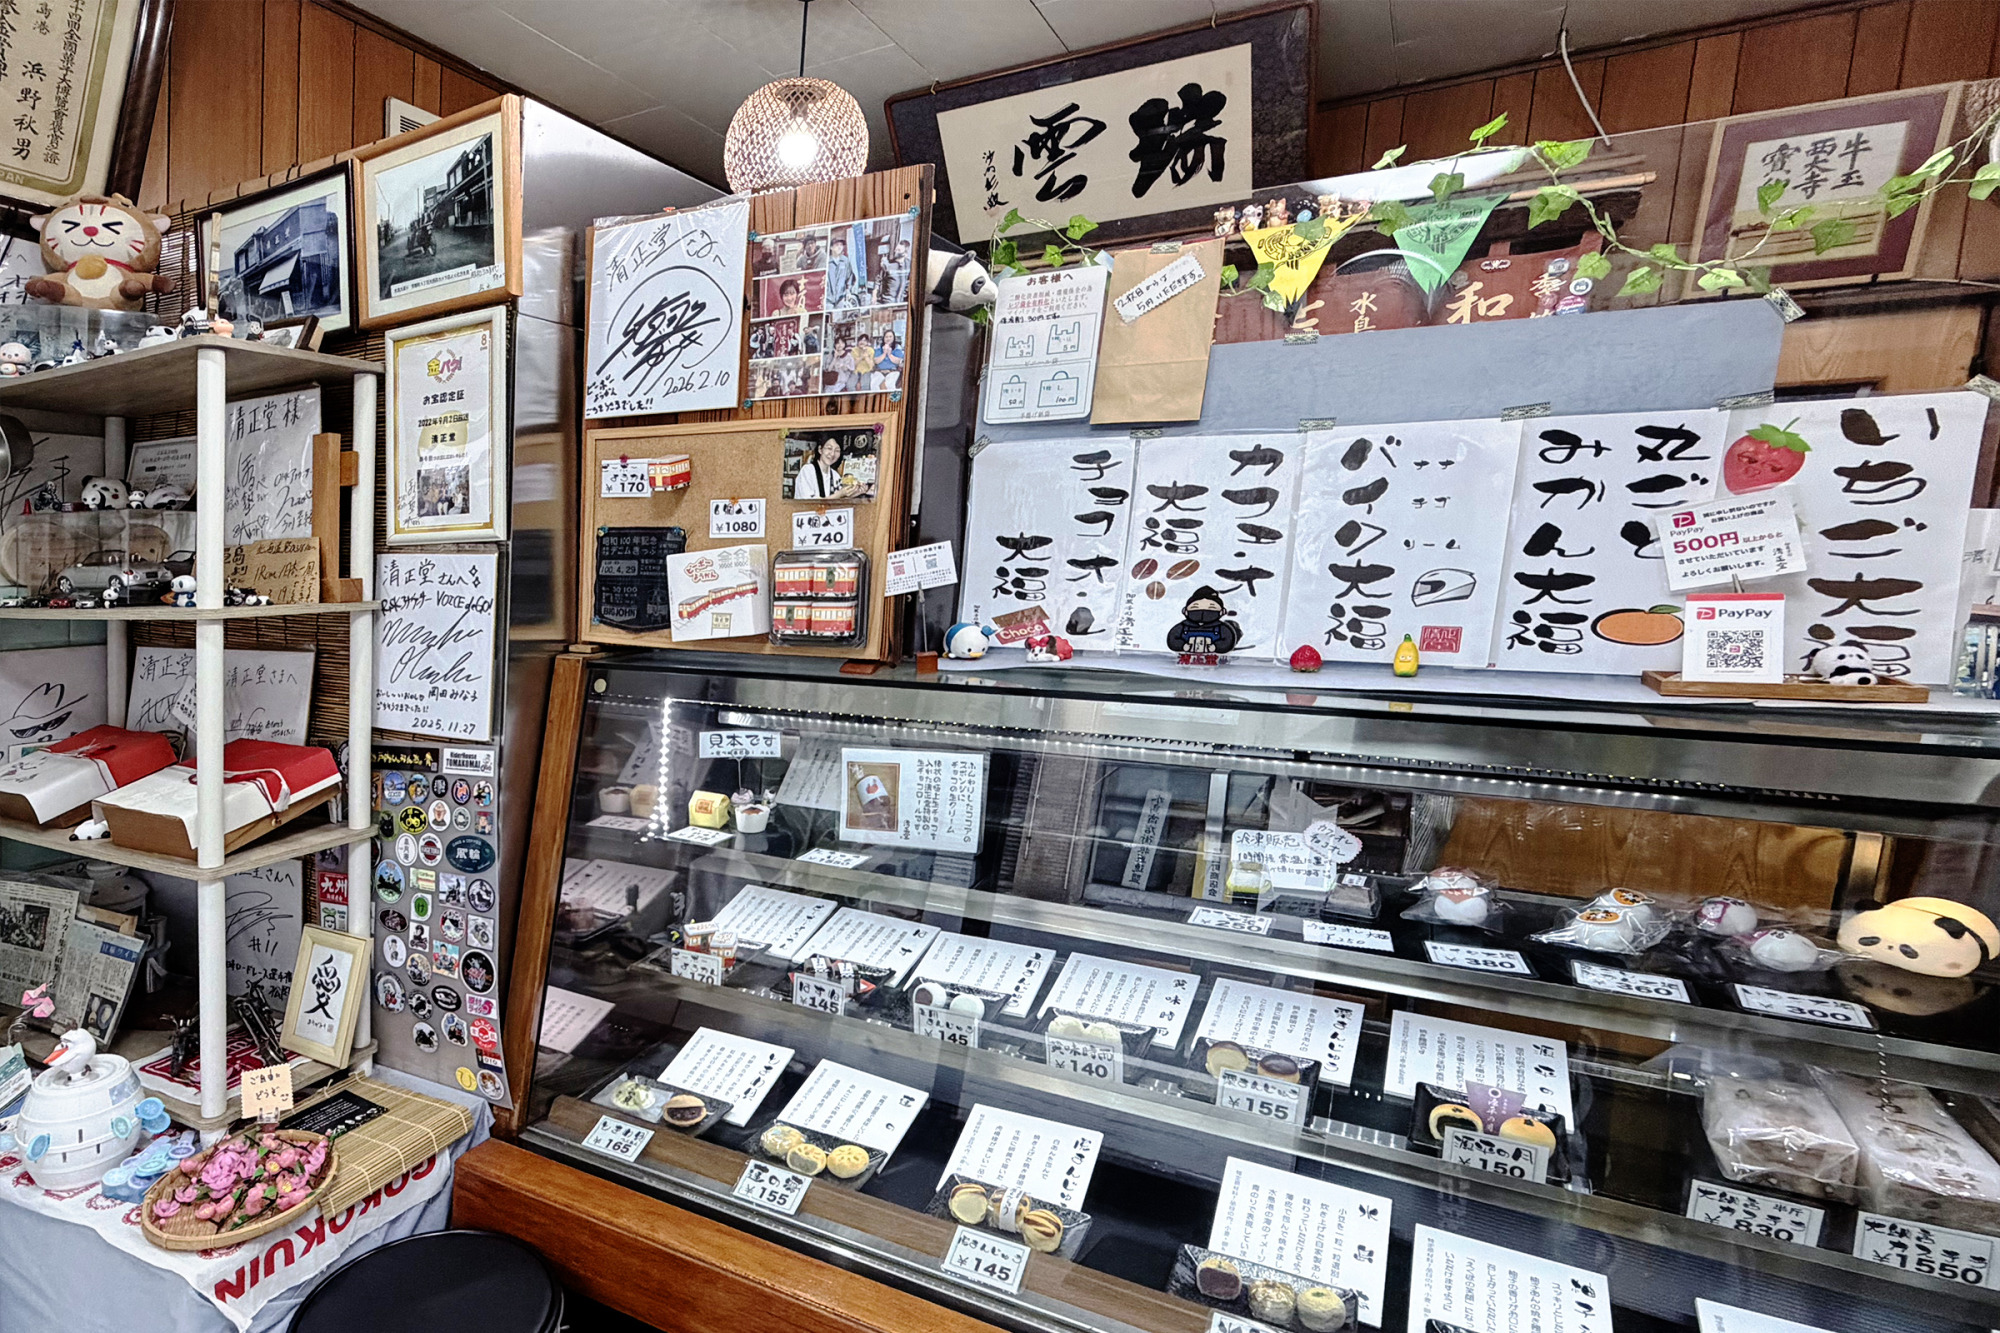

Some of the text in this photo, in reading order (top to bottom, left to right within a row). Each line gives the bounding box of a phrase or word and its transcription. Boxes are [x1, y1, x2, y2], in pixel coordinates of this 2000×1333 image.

[1027, 273, 1074, 286] お客様へ
[605, 482, 645, 493] ¥170
[715, 521, 757, 533] ¥1080
[1140, 480, 1210, 554] 大福
[798, 531, 844, 546] ¥740
[1670, 526, 1705, 537] PayPay
[1506, 428, 1612, 656] みかん大福
[1673, 531, 1740, 554] 500円
[992, 531, 1054, 602] 大福
[1681, 560, 1766, 577] よろしくお願いします。
[1718, 608, 1773, 620] PayPay
[1000, 623, 1044, 640] Choco
[411, 717, 477, 735] 2025.11.27
[710, 733, 776, 749] 見本です
[1236, 832, 1301, 847] 冷凍販売
[1445, 955, 1517, 971] ¥380
[304, 953, 342, 1020] 愛
[1593, 978, 1673, 998] ¥360
[799, 995, 841, 1015] ¥145
[1757, 1001, 1852, 1024] ¥300
[924, 1029, 969, 1047] ¥145
[1054, 1059, 1109, 1079] ¥140
[1227, 1095, 1290, 1120] ¥155
[591, 1136, 632, 1155] ¥165
[1459, 1155, 1526, 1179] ¥150
[744, 1183, 790, 1207] ¥155
[1704, 1212, 1794, 1242] ¥830
[957, 1254, 1011, 1282] ¥145
[1872, 1249, 1983, 1285] ¥1550
